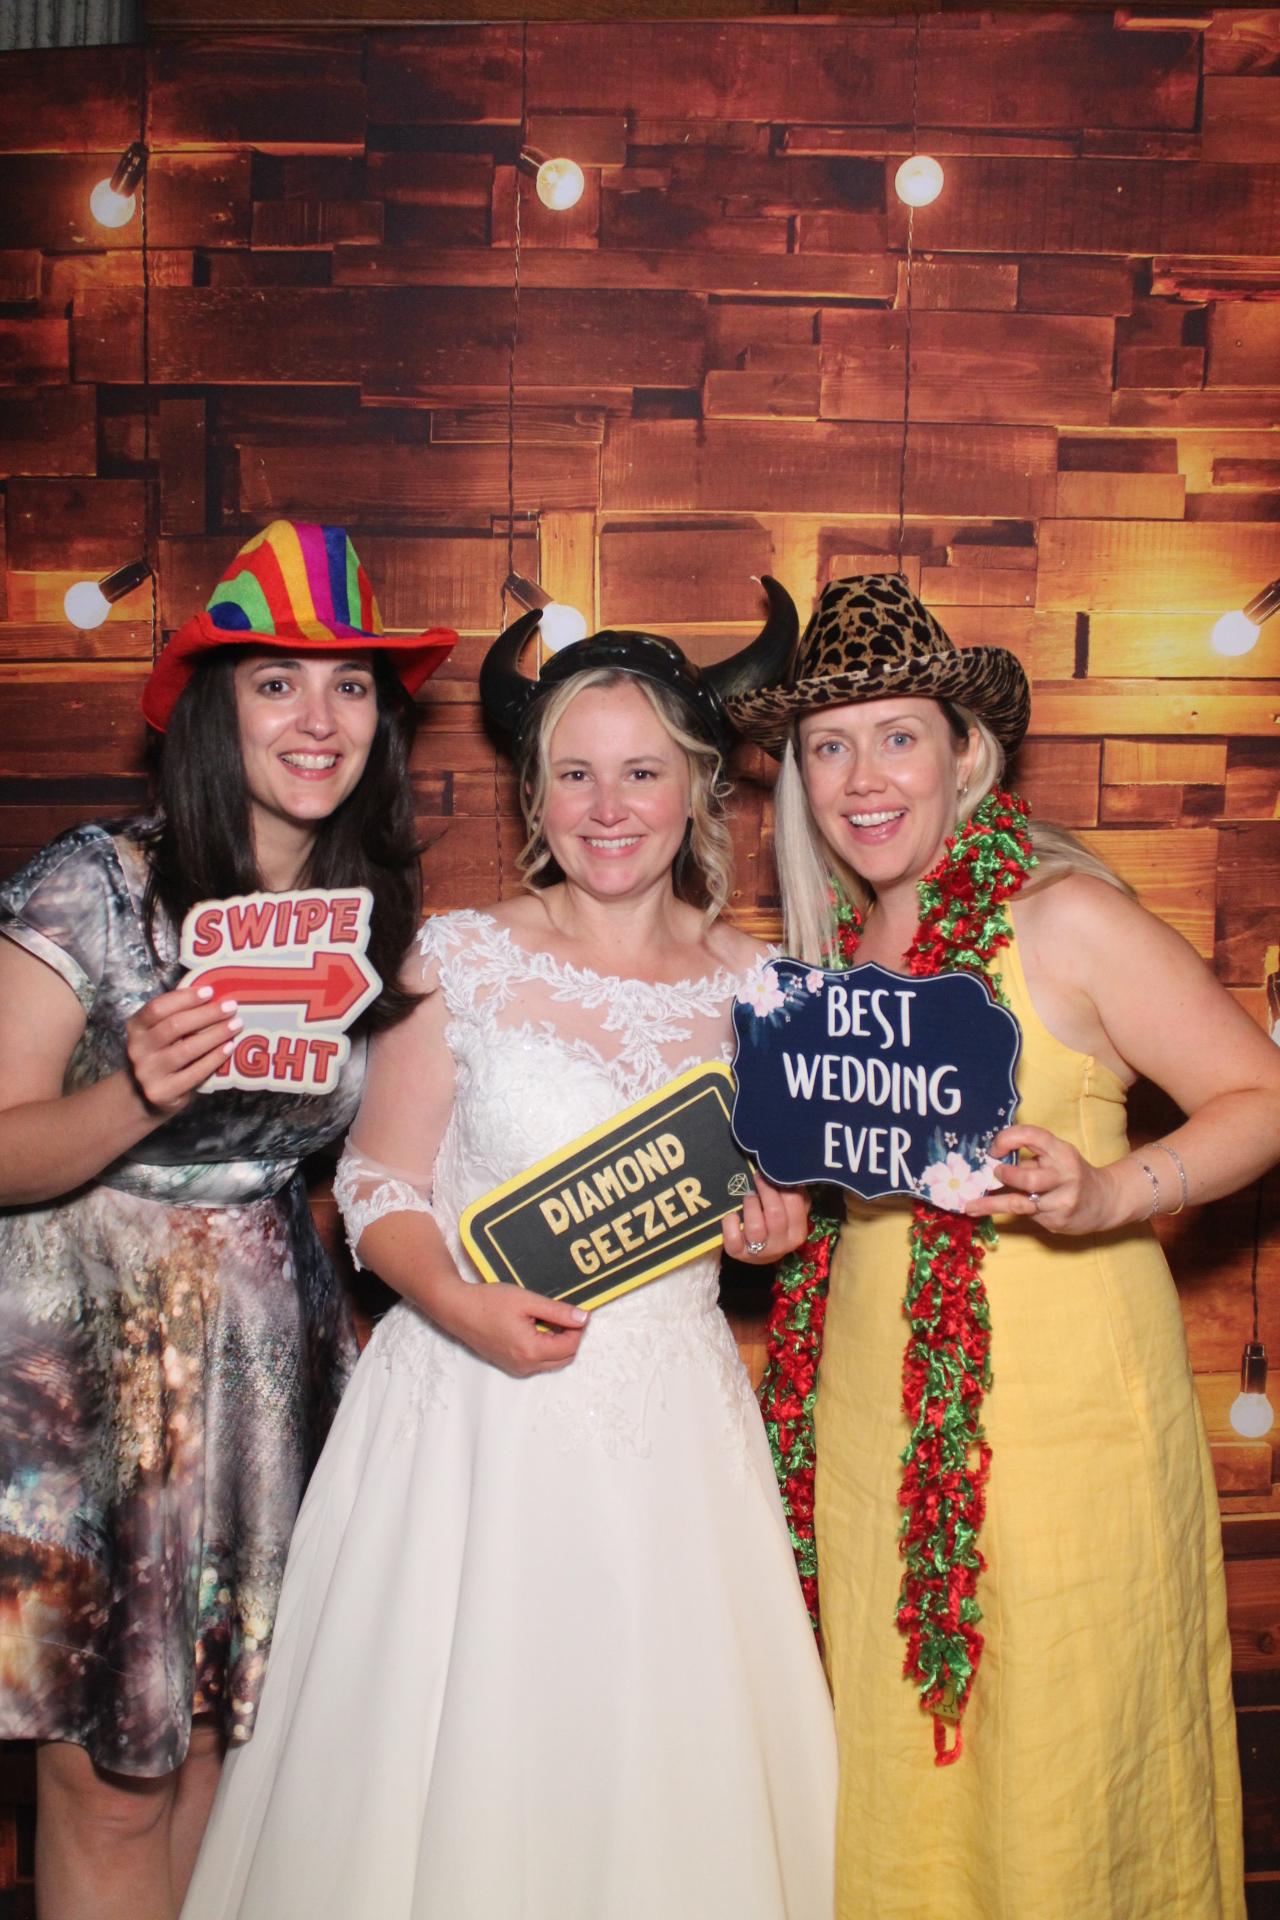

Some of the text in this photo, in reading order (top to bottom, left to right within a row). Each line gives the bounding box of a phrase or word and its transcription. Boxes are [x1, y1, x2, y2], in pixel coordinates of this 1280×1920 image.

[193, 897, 361, 957] SWIPE
[827, 985, 917, 1049] BEST
[214, 1034, 339, 1084] GHT
[782, 1052, 962, 1117] WEDDING
[539, 1133, 686, 1236] DIAMOND
[824, 1122, 915, 1191] EVER
[570, 1176, 712, 1275] GEEZER
